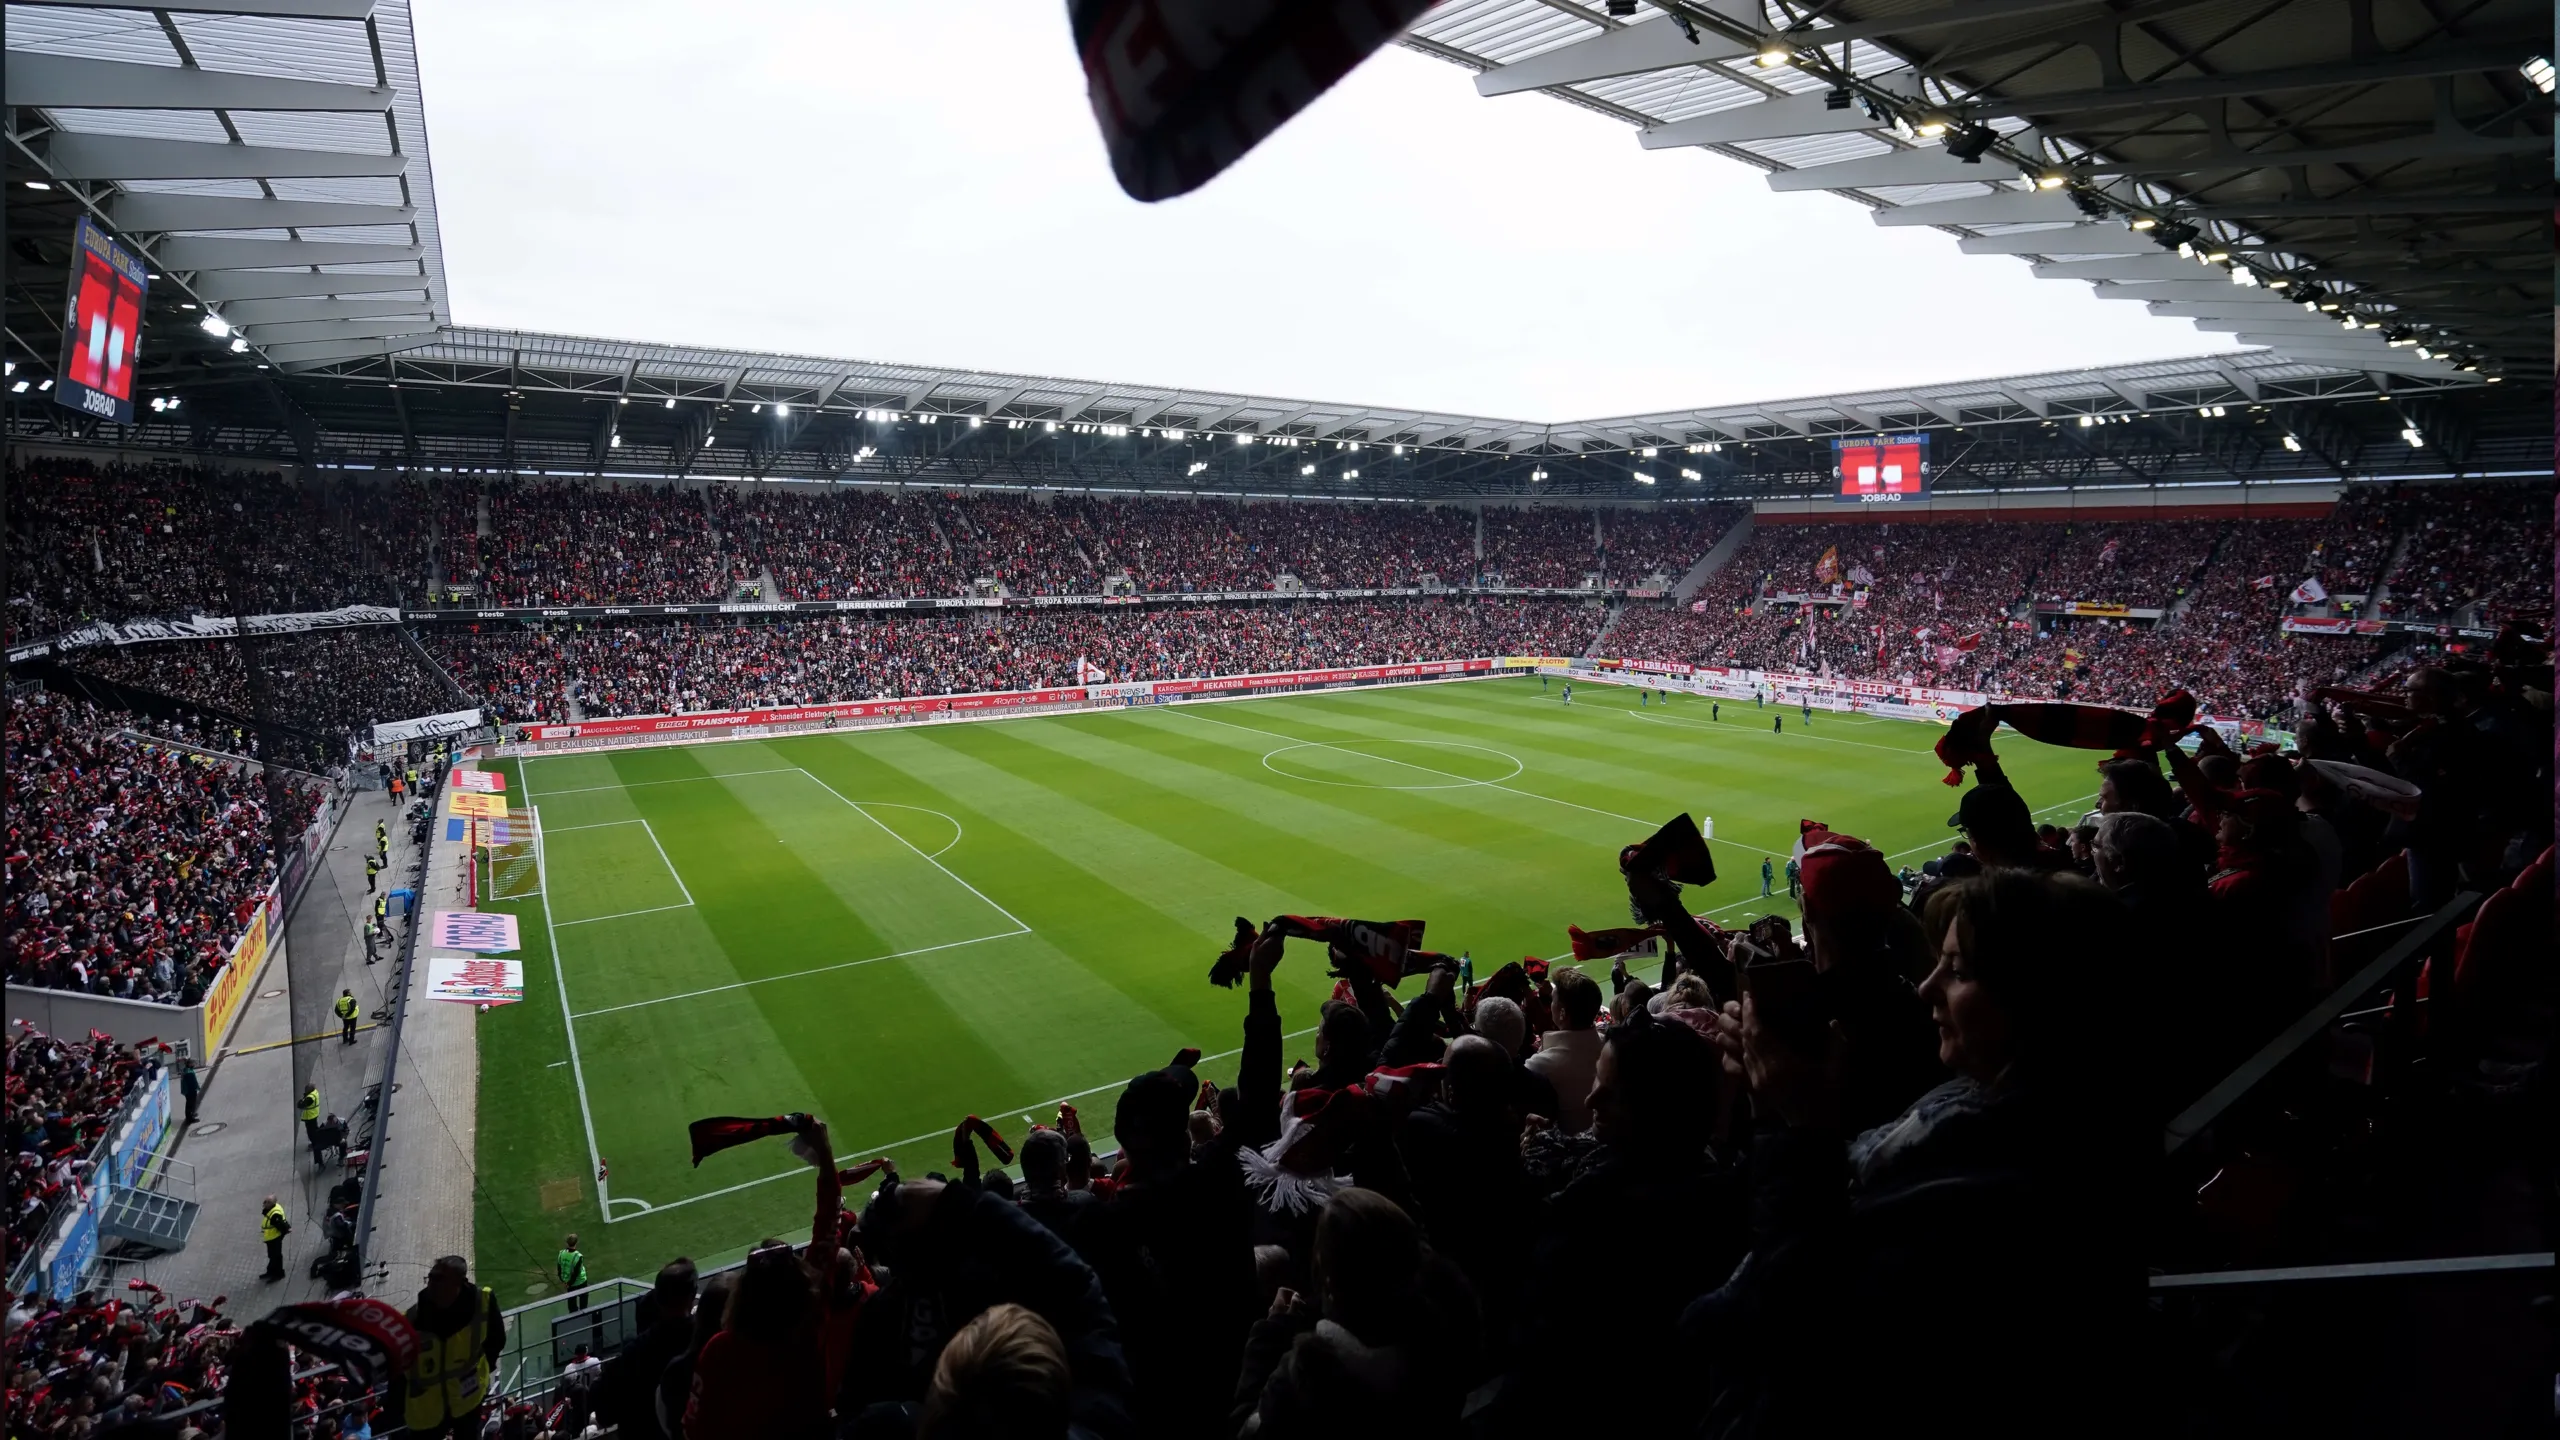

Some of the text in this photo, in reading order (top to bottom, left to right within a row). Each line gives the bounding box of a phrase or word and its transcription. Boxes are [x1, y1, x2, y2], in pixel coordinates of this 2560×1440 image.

[84, 226, 145, 285] EUROPA PARK Stadion
[83, 388, 115, 417] JOBRAD
[1838, 436, 1921, 448] EUROPA PARK Stadion
[1861, 493, 1901, 502] JOBRAD
[719, 604, 797, 612] HERRENKNECHT
[837, 601, 906, 609] HERRENKNECHT
[936, 599, 963, 607] EUROPA
[1386, 668, 1416, 676] Lexware
[1644, 661, 1691, 673] ERHALTEN
[1203, 680, 1243, 690] HEKATRON
[1100, 688, 1141, 697] FAIRways
[1093, 693, 1183, 708] EUROPA PARK Stadion
[874, 705, 907, 713] NEPERL
[770, 711, 803, 721] Schneider
[657, 716, 750, 729] STRECK TRANSPORT
[774, 724, 788, 733] DIE
[544, 730, 709, 750] DIE EXKLUSIVE NATURSTEINMANUFAKTUR
[247, 918, 263, 963] LOTTO
[217, 967, 238, 1014] LOTTO
